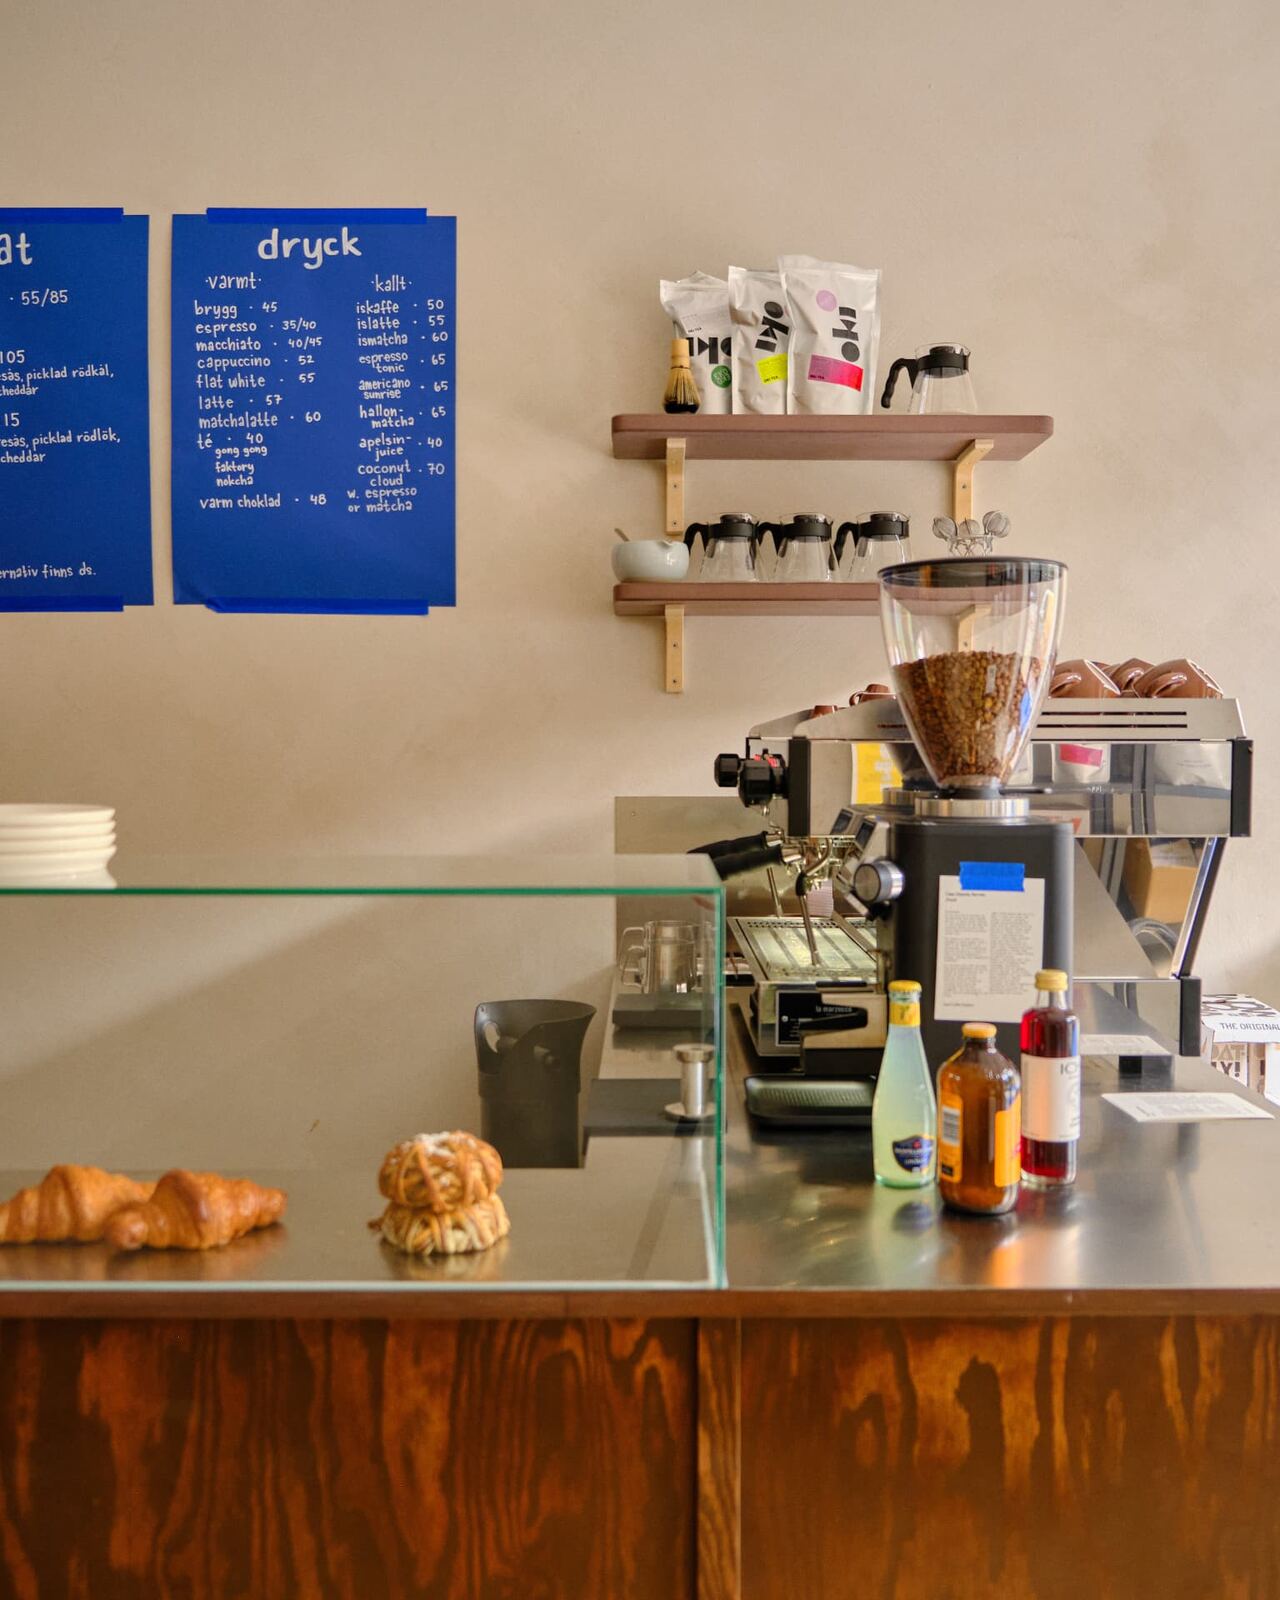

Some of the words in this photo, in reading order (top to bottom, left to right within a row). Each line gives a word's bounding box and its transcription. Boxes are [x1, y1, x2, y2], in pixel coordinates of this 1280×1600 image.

[258, 227, 361, 269] dryck
[22, 289, 67, 306] 55/85
[195, 300, 237, 319] brygg
[263, 302, 277, 312] 45
[357, 300, 399, 314] iskaffe
[428, 300, 443, 310] 50
[196, 321, 257, 337] espresso
[283, 317, 316, 332] 35/40
[358, 317, 400, 329] islatte
[429, 315, 445, 326] 55
[196, 337, 260, 351] macchiato
[288, 337, 322, 349] 40/45
[359, 332, 407, 346] ismatcha
[432, 332, 448, 342] 60
[198, 355, 271, 373] cappuccino
[299, 355, 314, 365] 52
[359, 353, 408, 368] espresso
[432, 354, 445, 365] 65
[376, 363, 405, 373] tonic
[27, 367, 67, 387] picklad
[196, 374, 222, 388] flat
[229, 373, 265, 388] white
[299, 373, 315, 383] 55
[359, 379, 411, 390] americano
[434, 381, 448, 392] 65
[364, 389, 402, 400] sunrise
[200, 396, 233, 409] latte
[266, 395, 282, 405] 57
[432, 406, 446, 417] 65
[199, 412, 277, 428] matchalatte
[306, 412, 321, 422] 60
[372, 416, 414, 428] matcha
[33, 431, 72, 450] picklad
[198, 434, 212, 449] té
[247, 433, 263, 443] 40
[360, 433, 412, 451] apelsin-
[428, 437, 442, 448] 40
[1, 450, 45, 462] cheddar
[215, 448, 239, 458] gong
[243, 446, 267, 457] gong
[376, 446, 404, 461] juice
[216, 461, 254, 474] faktory
[358, 460, 411, 475] coconut
[428, 463, 444, 474] 70
[217, 475, 253, 486] nokcha
[370, 475, 403, 486] cloud
[366, 485, 416, 501] espresso
[200, 498, 232, 508] varm
[238, 493, 280, 508] choklad
[310, 494, 326, 505] 48
[367, 499, 412, 512] matcha
[42, 565, 72, 577] finns
[1220, 1022, 1239, 1030] THE
[1240, 1022, 1280, 1031] ORIGINAL
